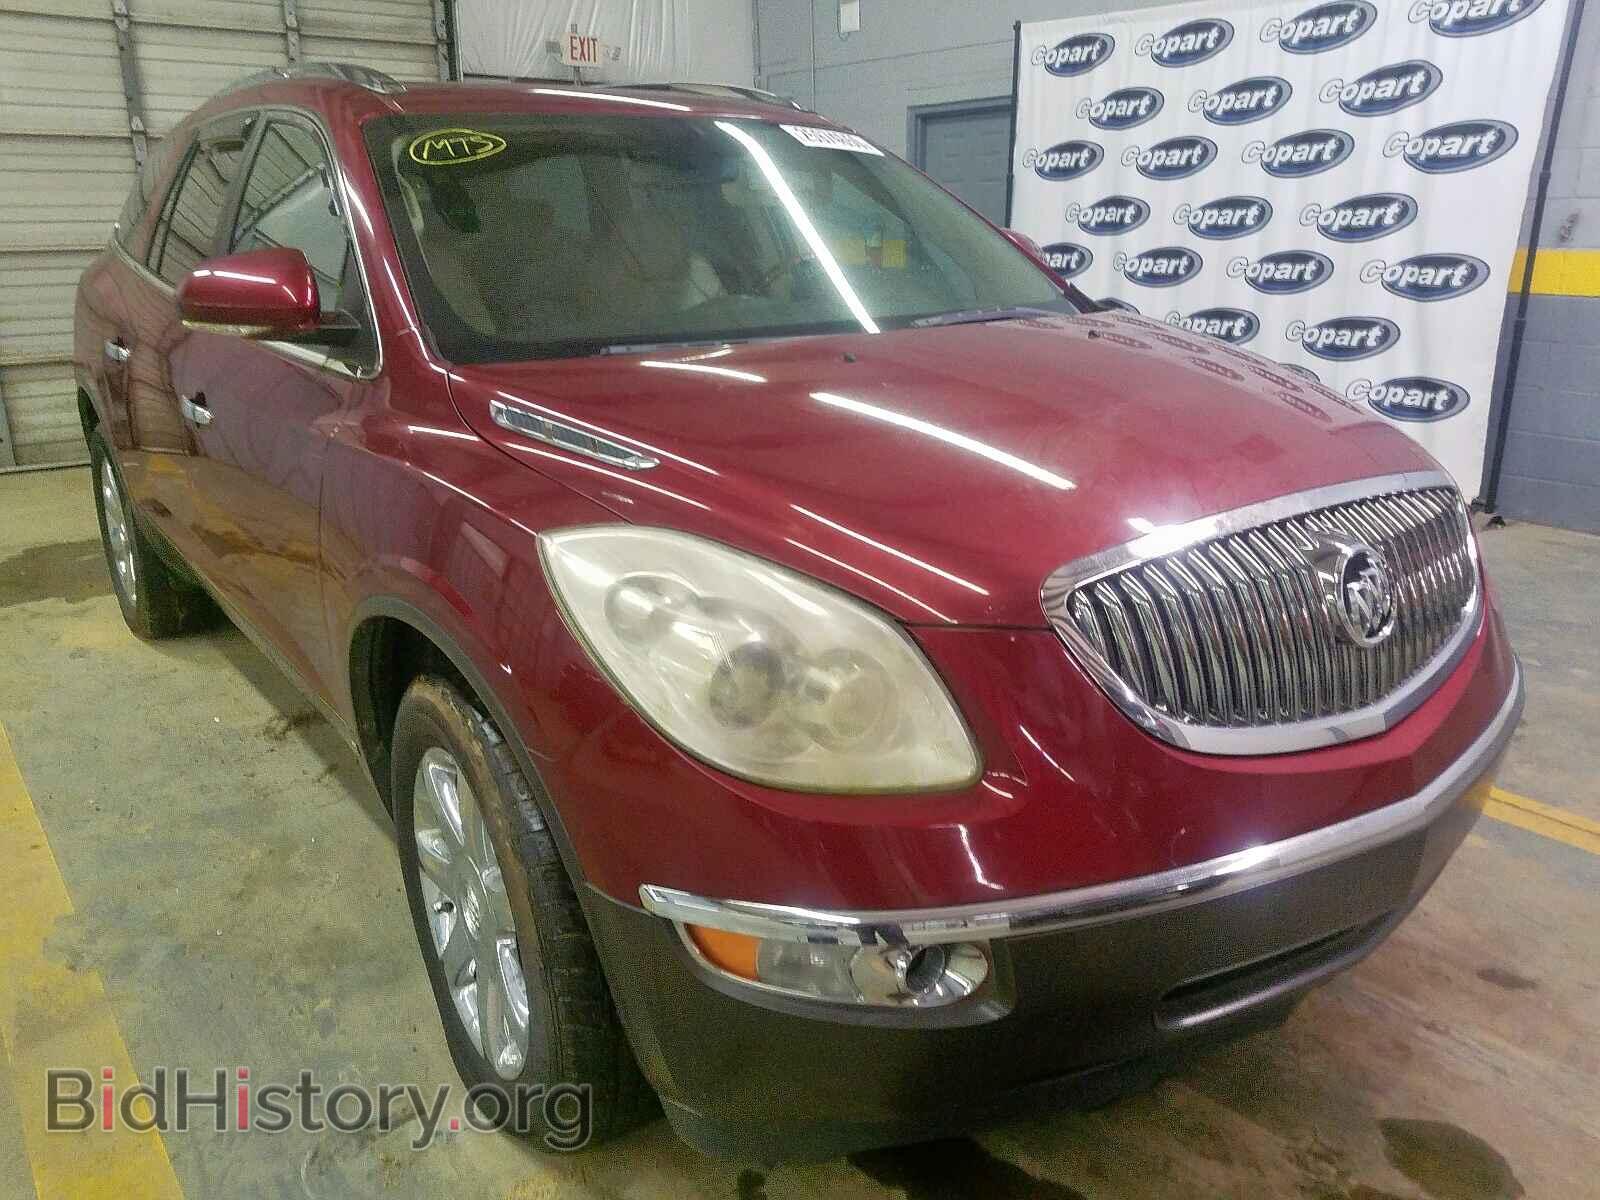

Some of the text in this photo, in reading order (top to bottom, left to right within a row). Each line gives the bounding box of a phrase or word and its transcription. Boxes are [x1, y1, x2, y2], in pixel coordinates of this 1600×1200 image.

[1135, 26, 1219, 57] Copart
[1260, 7, 1361, 46] Copart
[570, 35, 598, 63] EXIT
[1032, 43, 1101, 68] Copart
[1188, 84, 1277, 115] Copart
[1319, 69, 1427, 106] Copart
[1076, 94, 1150, 123] Copart
[1022, 147, 1090, 171] Copart
[1121, 142, 1202, 171] Copart
[1241, 136, 1338, 168] Copart
[1383, 126, 1500, 163] Copart
[1065, 202, 1137, 227] Copart
[1173, 203, 1260, 230] Copart
[1300, 201, 1402, 233] Copart
[1113, 250, 1188, 277] Copart
[1226, 256, 1317, 284] Copart
[1360, 259, 1472, 289] Copart
[1286, 320, 1384, 350] Copart
[1346, 379, 1450, 411] Copart
